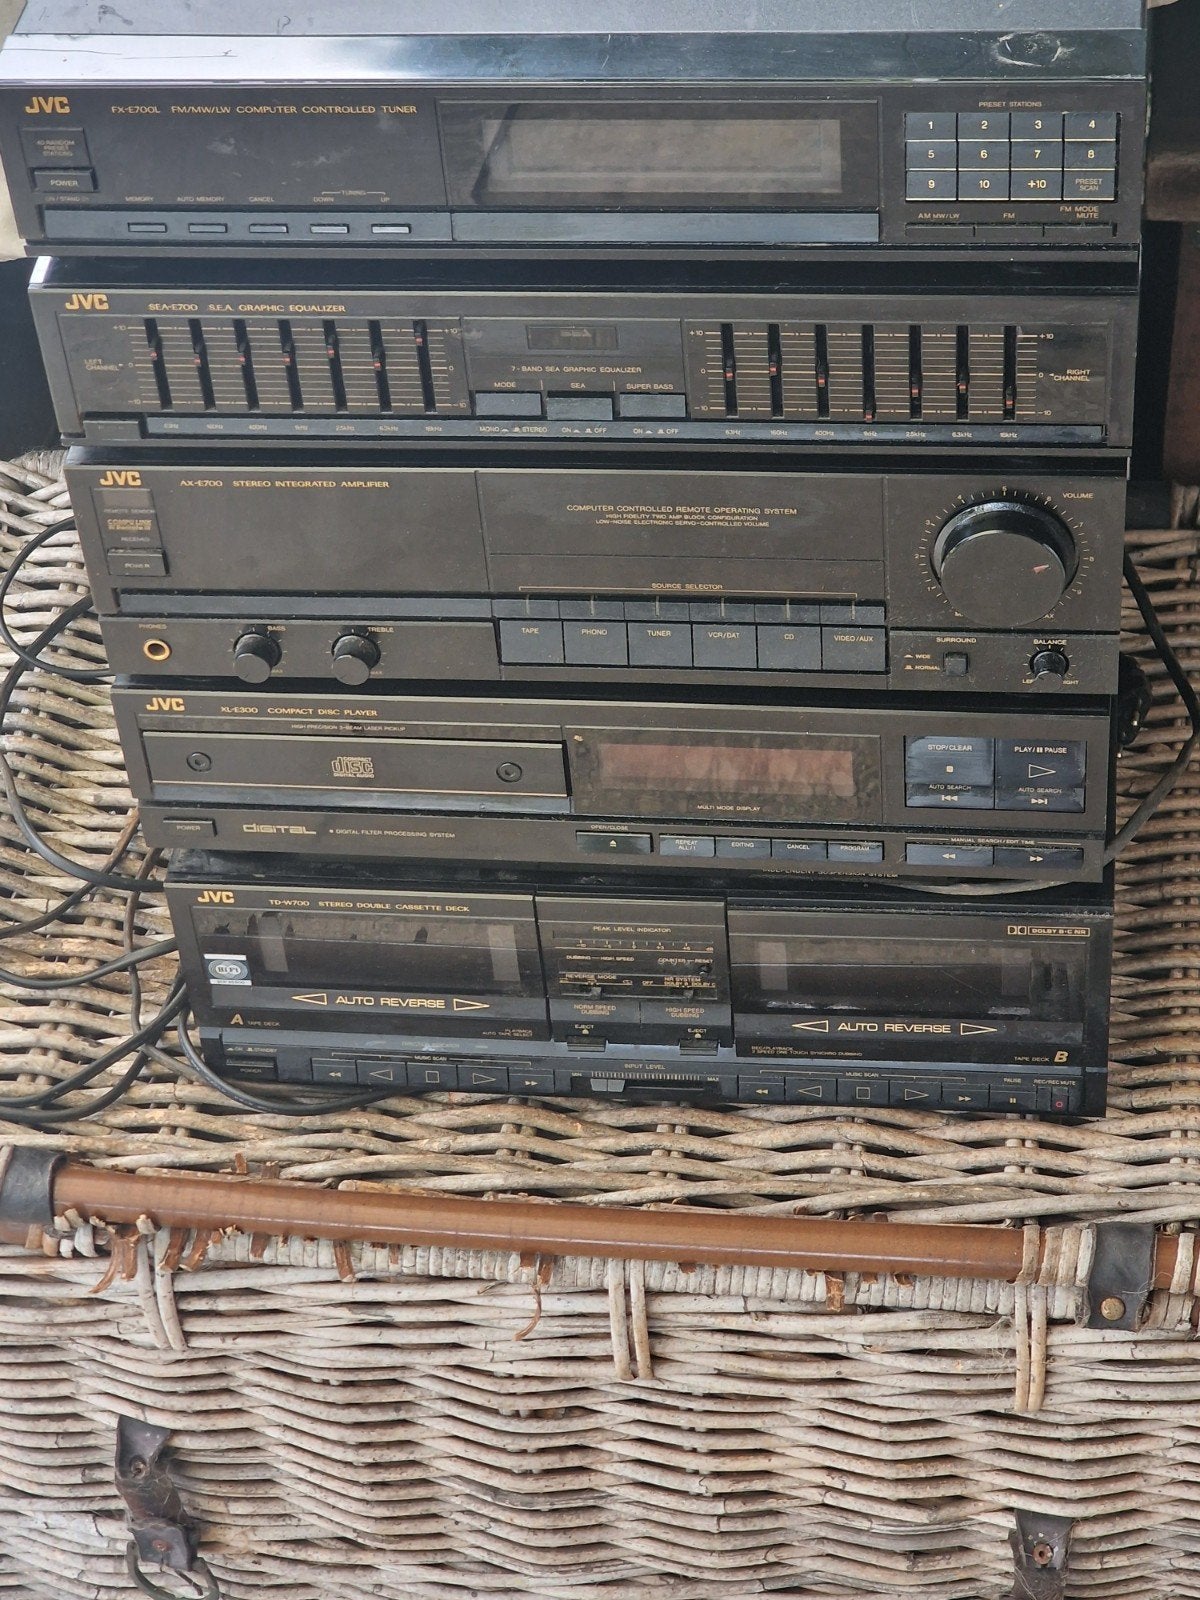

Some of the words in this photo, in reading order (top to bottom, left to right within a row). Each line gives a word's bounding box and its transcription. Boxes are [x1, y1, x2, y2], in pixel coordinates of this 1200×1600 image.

[25, 96, 70, 114] JVC
[110, 105, 161, 114] FX-E700L
[170, 105, 231, 115] FM/MW/LW
[236, 105, 298, 115] COMPUTER
[302, 105, 376, 115] CONTROLLED
[381, 105, 417, 114] TUNER
[928, 121, 934, 130] 1
[981, 121, 988, 130] 2
[1034, 121, 1042, 130] 3
[1088, 121, 1096, 129] 4
[928, 150, 935, 159] 5
[980, 150, 988, 159] 6
[1034, 150, 1041, 159] 7
[1087, 150, 1095, 158] 8
[50, 179, 78, 187] POWER
[928, 179, 935, 189] 9
[979, 180, 990, 189] 10
[1028, 180, 1046, 189] +10
[65, 294, 109, 310] JVC
[238, 304, 285, 312] GRAPHIC
[289, 304, 346, 312] EQUALIZER
[563, 366, 597, 374] GRAPHIC
[99, 470, 142, 486] JVC
[179, 480, 223, 488] AX-E700
[232, 480, 271, 488] STEREO
[275, 480, 336, 488] INTEGRATED
[341, 480, 389, 489] AMPLIFIER
[617, 505, 673, 513] CONTROLLED
[714, 507, 761, 515] OPERATING
[146, 697, 185, 711] JVC
[220, 706, 258, 714] XL-E300
[267, 707, 314, 715] COMPACT
[928, 744, 973, 752] STOP/CLEAR
[197, 890, 235, 904] JVC
[268, 899, 310, 907] TD-W700
[318, 900, 353, 908] STEREO
[356, 901, 391, 909] DOUBLE
[395, 903, 442, 911] CASSETTE
[336, 995, 375, 1006] AUTO
[380, 997, 446, 1009] REVERSE
[230, 1013, 244, 1025] A
[837, 1022, 878, 1032] AUTO
[884, 1023, 951, 1034] REVERSE
[1053, 1050, 1069, 1063] B
